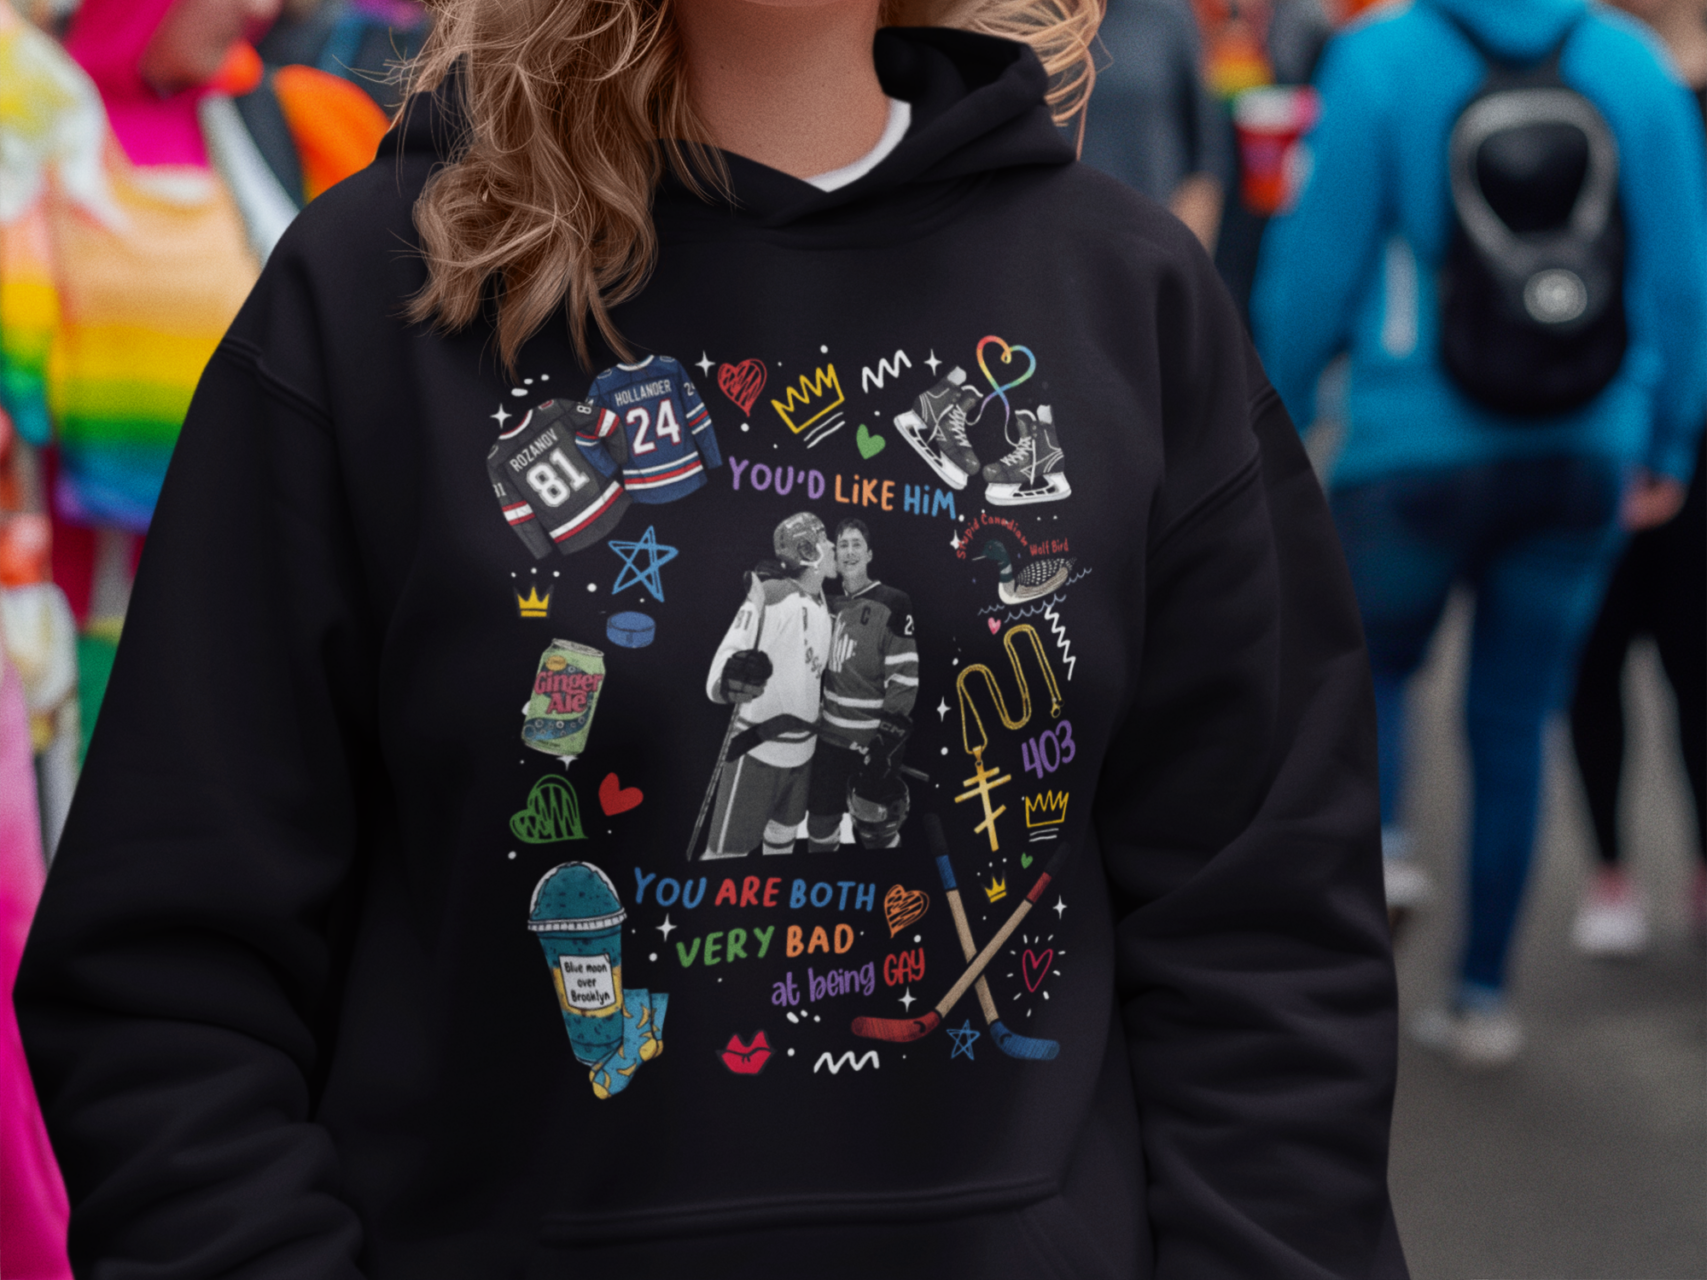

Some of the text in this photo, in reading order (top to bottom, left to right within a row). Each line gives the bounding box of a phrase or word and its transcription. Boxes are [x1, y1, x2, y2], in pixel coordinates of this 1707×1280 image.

[615, 379, 671, 407] HOLLANDER
[625, 397, 681, 456] 24
[509, 427, 558, 472] ROZANOV
[526, 447, 590, 508] 81
[729, 456, 825, 499] YOU'D
[956, 517, 980, 560] Stupid
[1051, 537, 1069, 554] Bird
[904, 614, 915, 635] 2
[534, 670, 604, 696] Ginger
[546, 691, 588, 714] Ale
[1021, 719, 1076, 779] 403
[634, 867, 876, 912] YOU ARE BOTH
[564, 961, 607, 973] Blue moon
[675, 923, 854, 968] VERY BAD
[571, 989, 610, 1005] Brooklyn
[577, 978, 596, 988] over
[771, 947, 926, 1007] at being GAY
